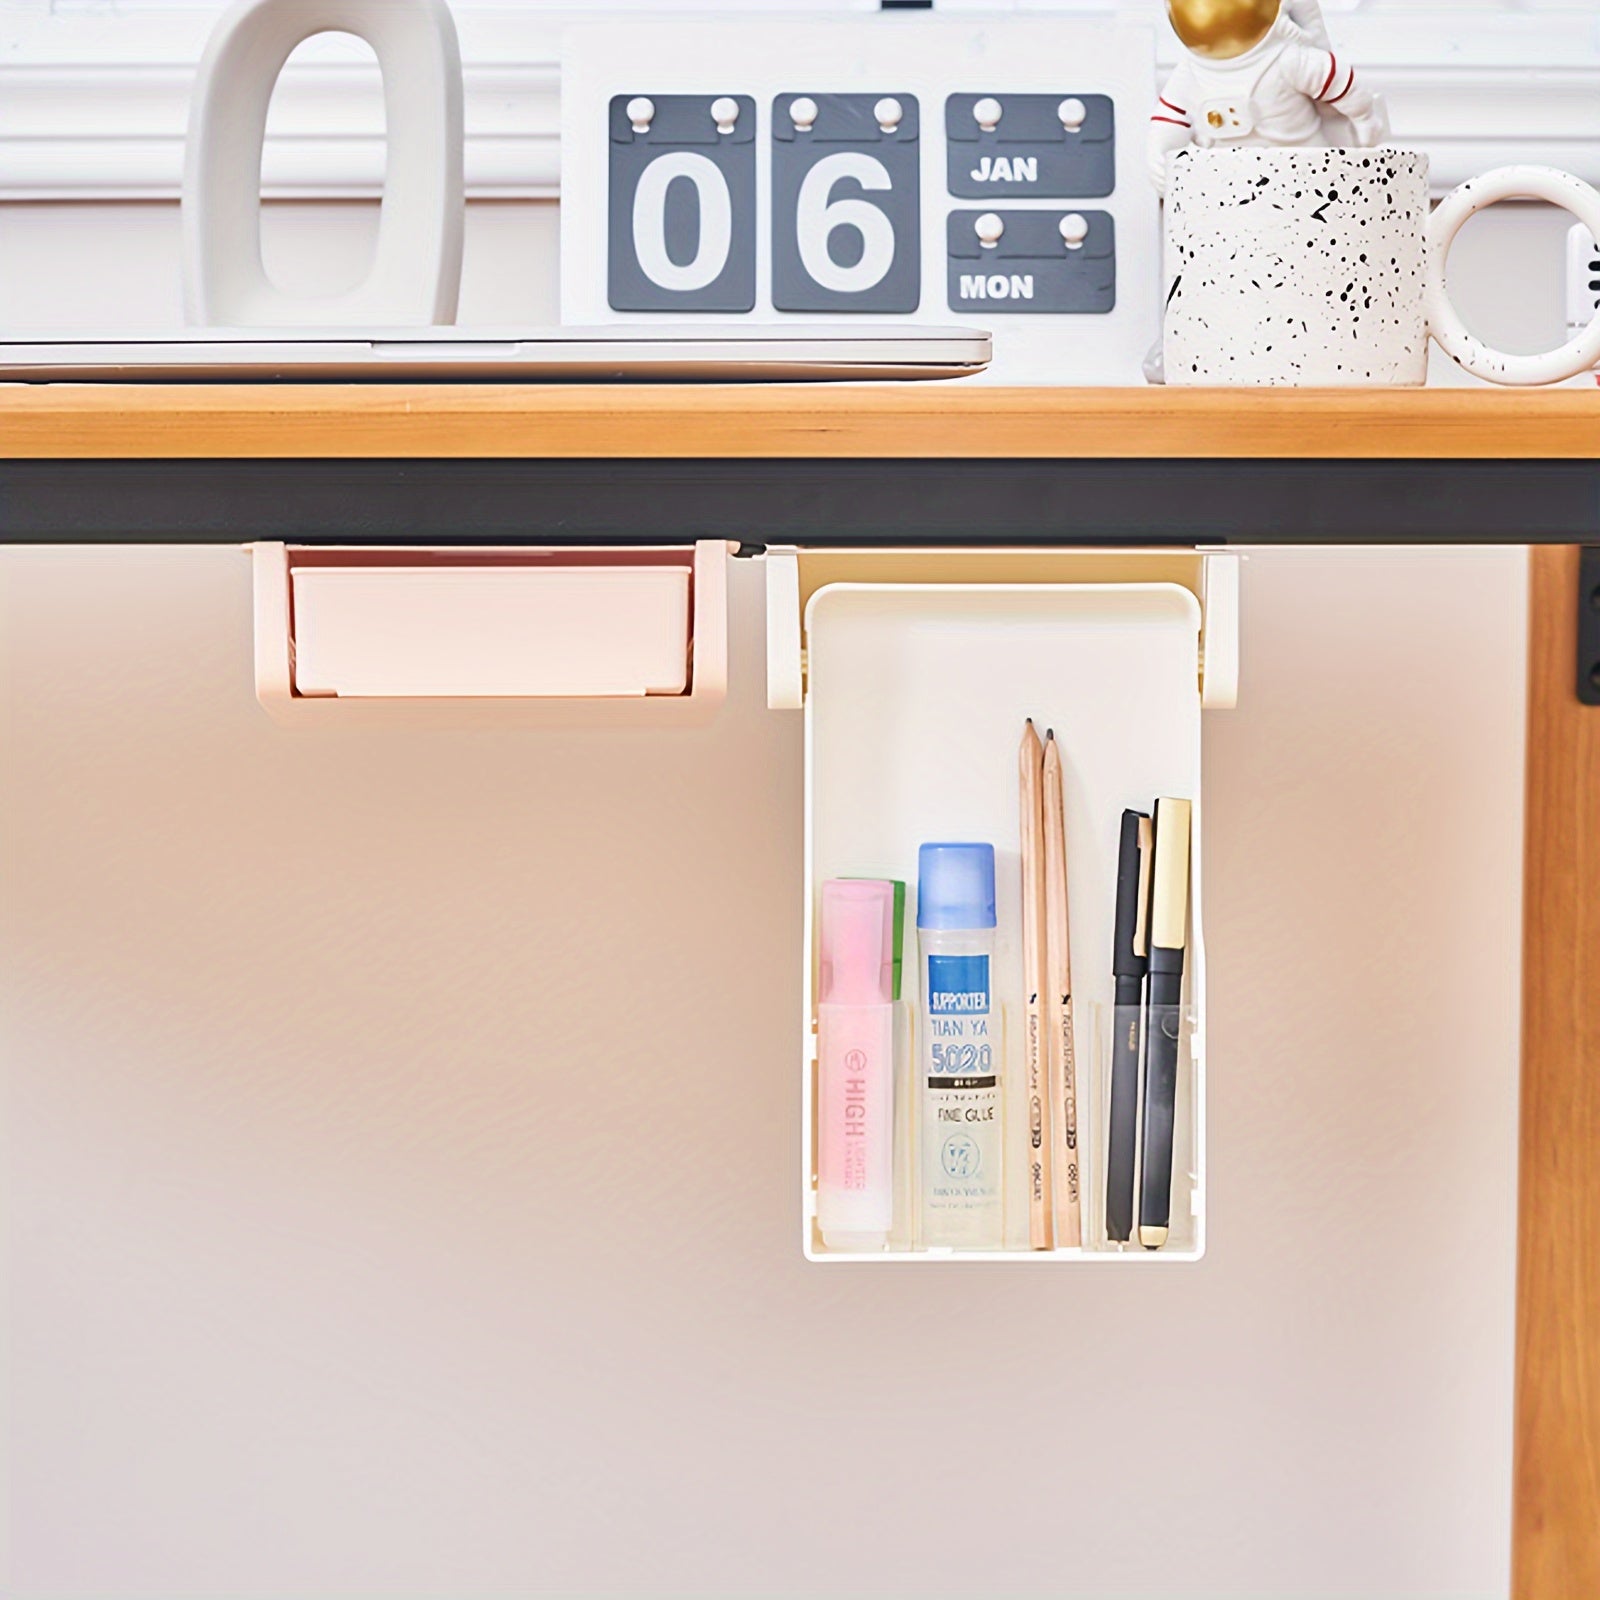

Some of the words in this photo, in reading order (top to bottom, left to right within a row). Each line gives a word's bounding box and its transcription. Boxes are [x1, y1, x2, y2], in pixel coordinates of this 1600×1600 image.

[970, 156, 1038, 182] JAN
[959, 274, 1034, 300] MON
[931, 1019, 964, 1037] TIAN
[970, 1019, 988, 1036] YA
[931, 1043, 993, 1074] 5020
[845, 1079, 866, 1137] HIGH
